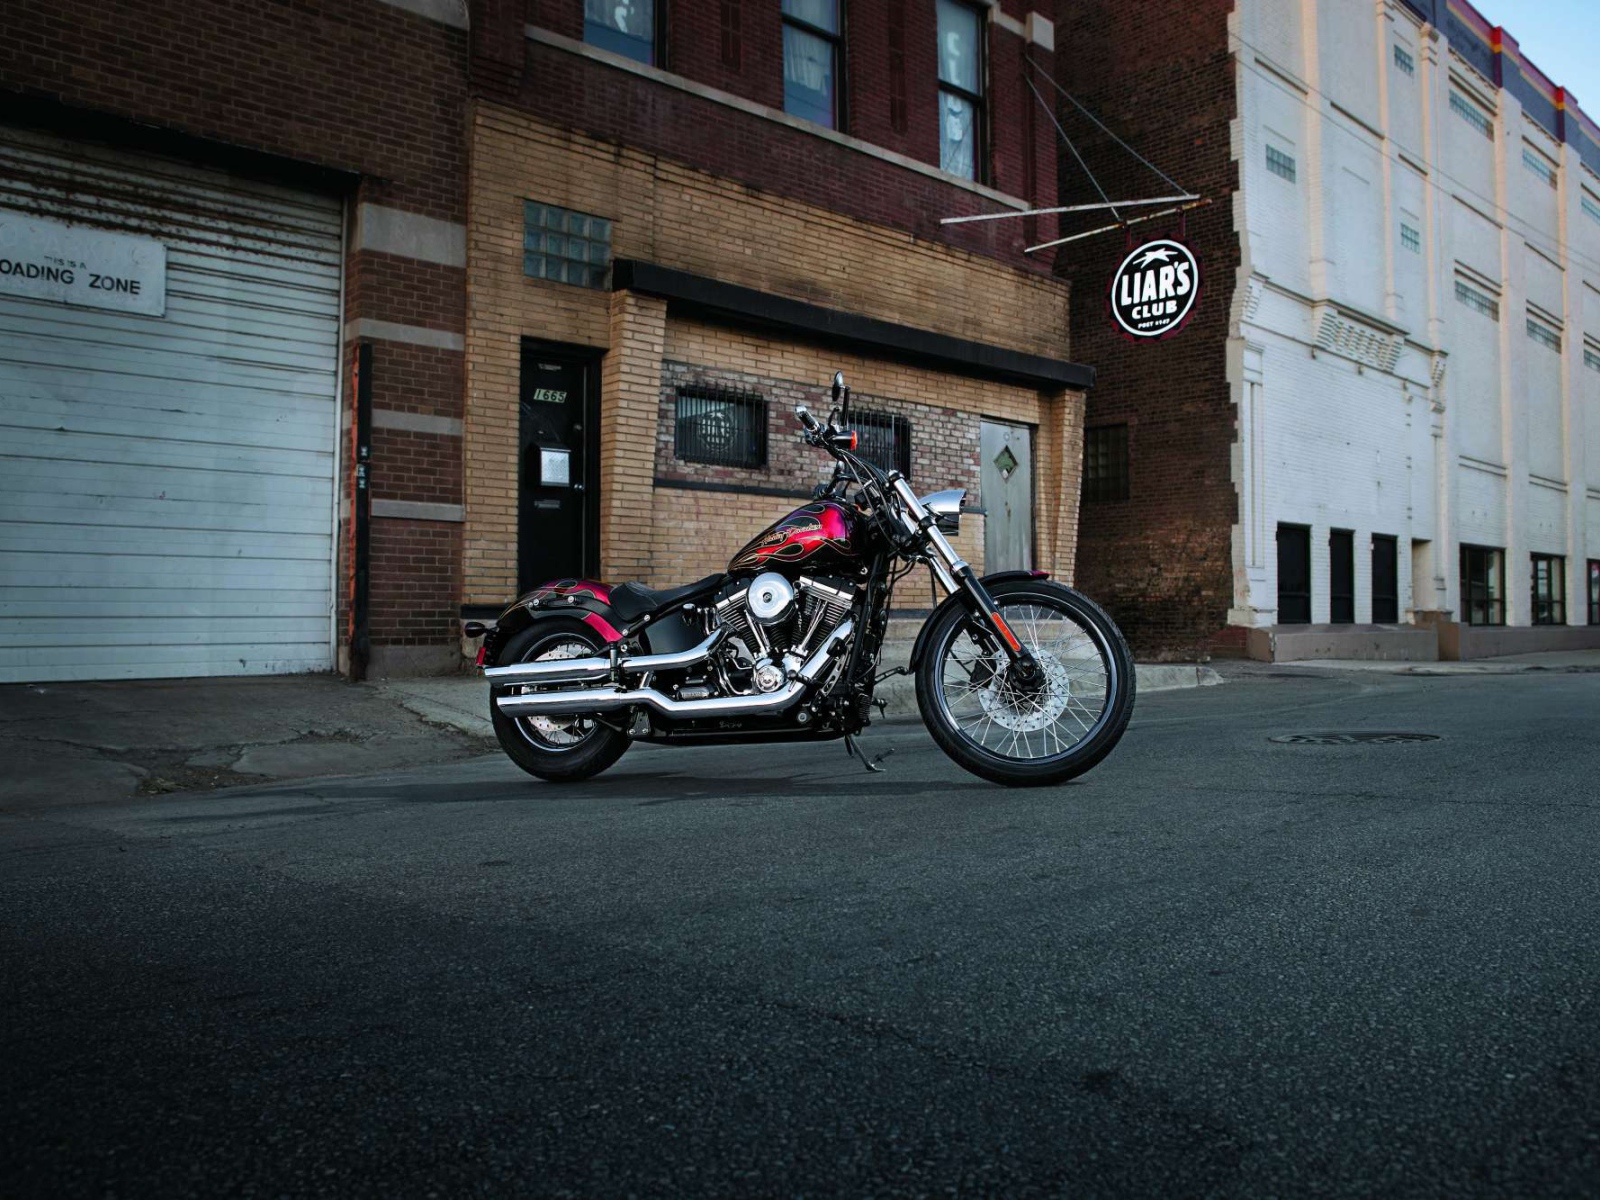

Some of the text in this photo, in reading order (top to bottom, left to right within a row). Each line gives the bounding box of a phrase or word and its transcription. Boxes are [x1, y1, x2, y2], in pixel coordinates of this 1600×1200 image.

[88, 273, 141, 295] ZONE
[1121, 261, 1191, 306] LIAR'S
[1131, 300, 1178, 319] CLUB
[536, 389, 565, 402] 1665
